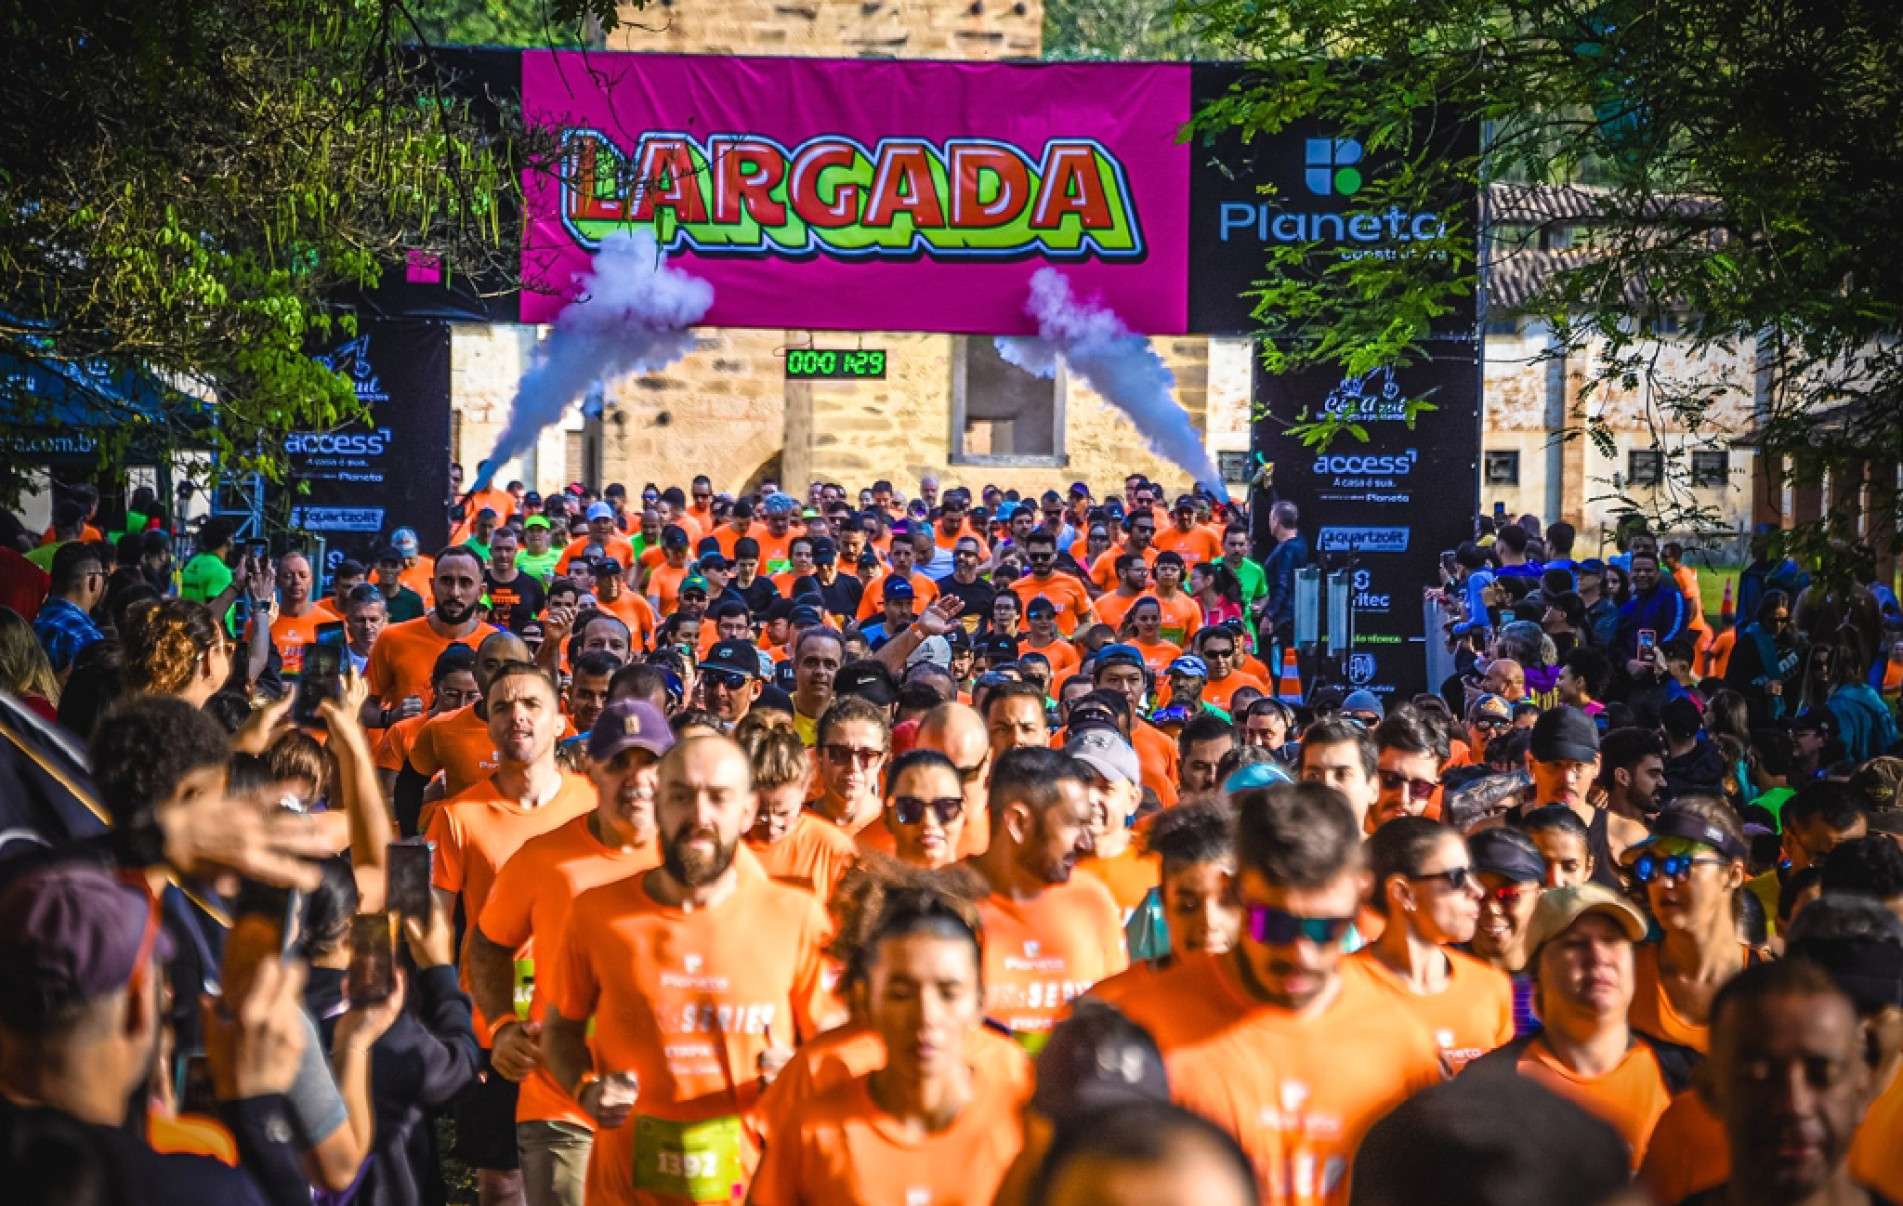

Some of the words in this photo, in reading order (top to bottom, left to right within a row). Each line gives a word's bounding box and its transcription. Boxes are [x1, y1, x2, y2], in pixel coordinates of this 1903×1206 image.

[562, 130, 1143, 256] LARGADA
[1219, 201, 1447, 242] Planeta
[284, 433, 384, 455] access
[1313, 454, 1410, 475] access
[337, 472, 384, 482] Planeta
[1341, 479, 1364, 487] casa
[1375, 479, 1396, 488] sua.
[1365, 492, 1410, 502] Planeta
[310, 511, 379, 524] quartzolit
[1335, 529, 1405, 544] quartzolit
